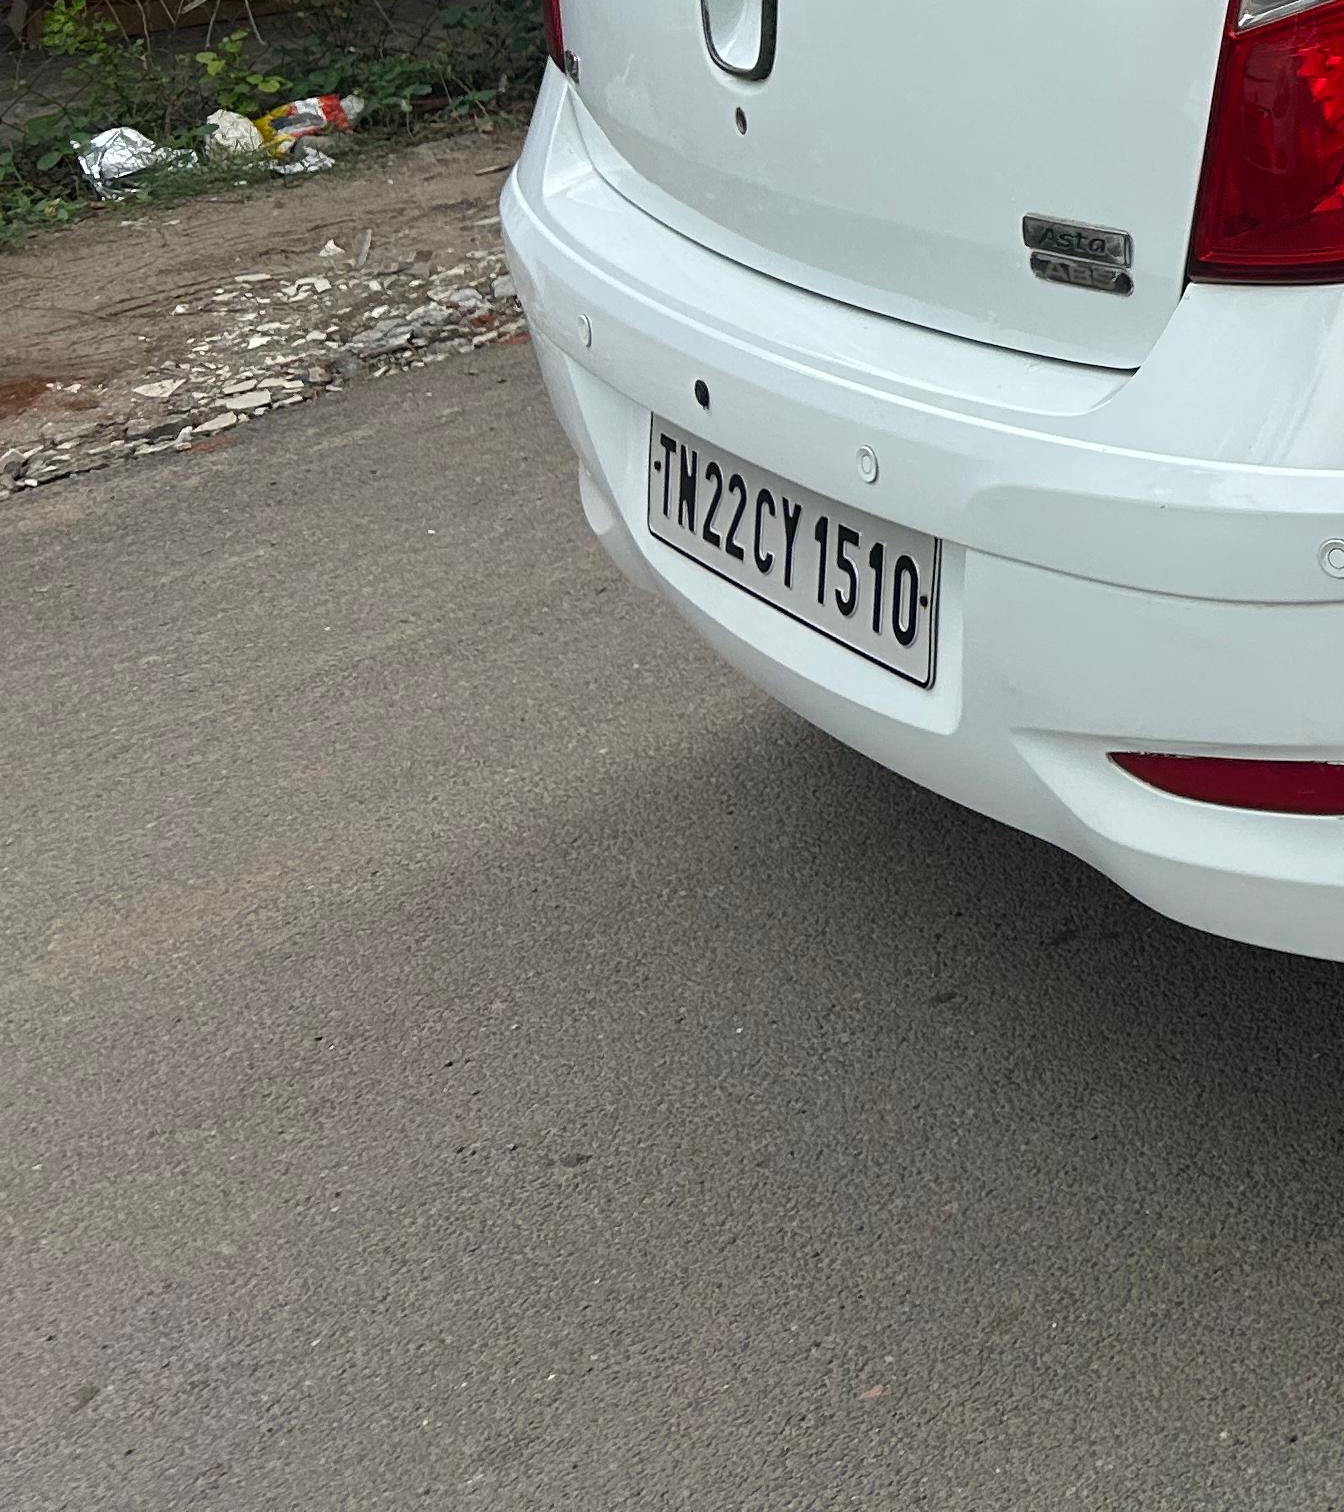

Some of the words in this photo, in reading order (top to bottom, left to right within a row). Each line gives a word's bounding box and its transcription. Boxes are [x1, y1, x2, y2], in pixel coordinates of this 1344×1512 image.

[1039, 228, 1106, 252] Asta
[660, 433, 803, 589] TN22CY
[814, 515, 921, 647] 1510
